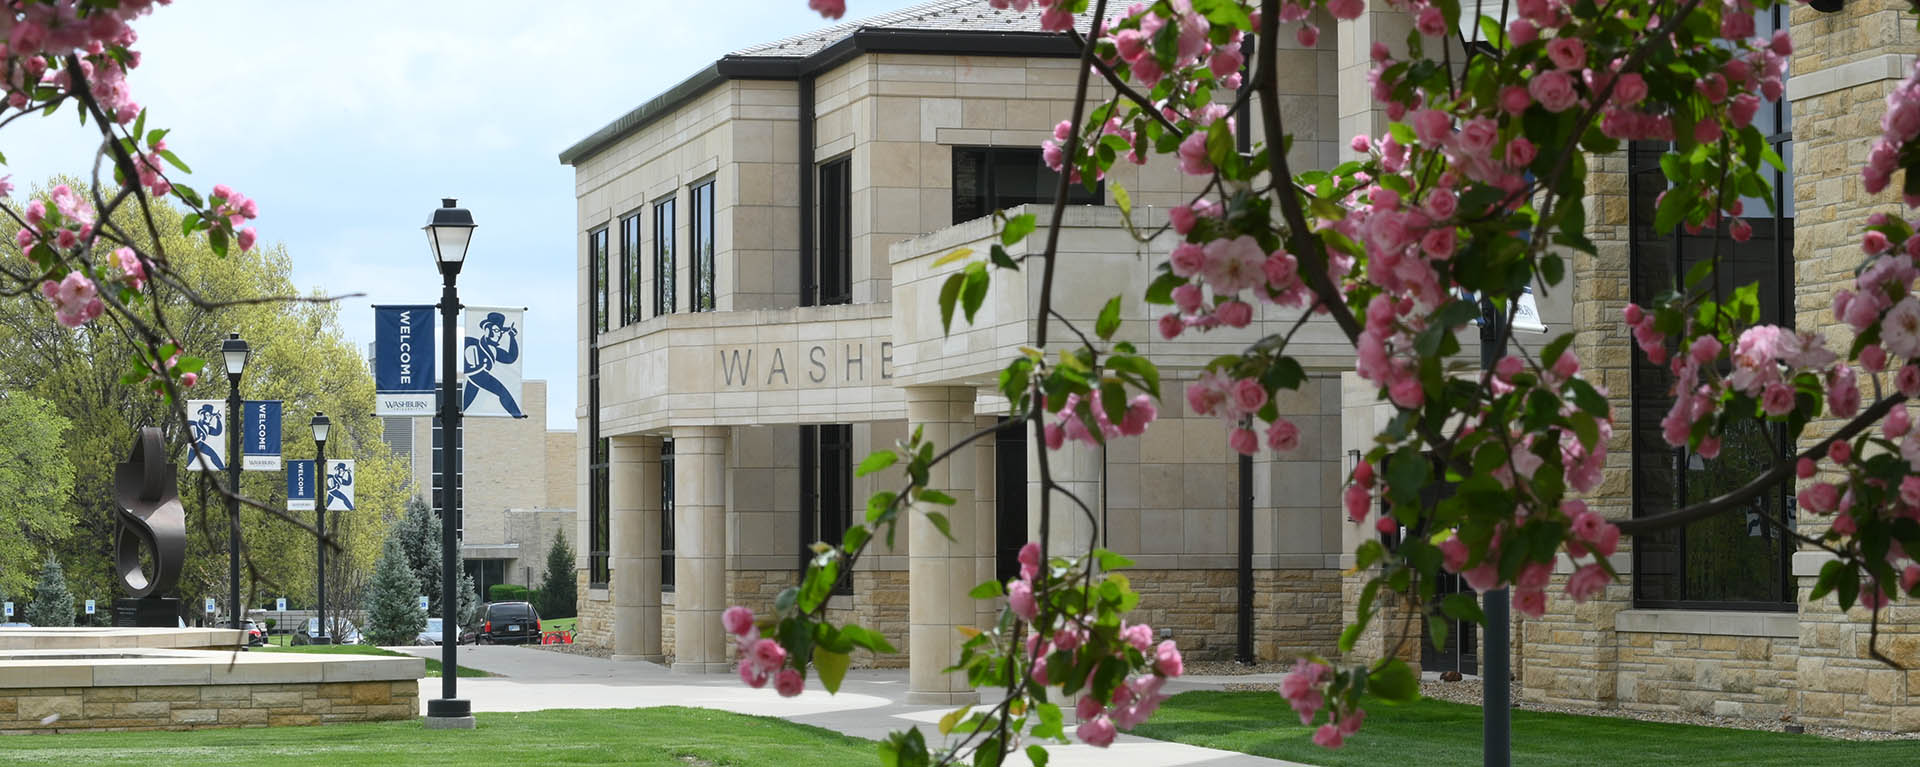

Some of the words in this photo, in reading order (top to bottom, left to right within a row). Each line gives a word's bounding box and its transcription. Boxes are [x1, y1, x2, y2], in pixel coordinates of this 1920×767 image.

[400, 311, 411, 385] WELCOME
[258, 404, 267, 450] WELCOME
[385, 400, 428, 409] WASHBURN
